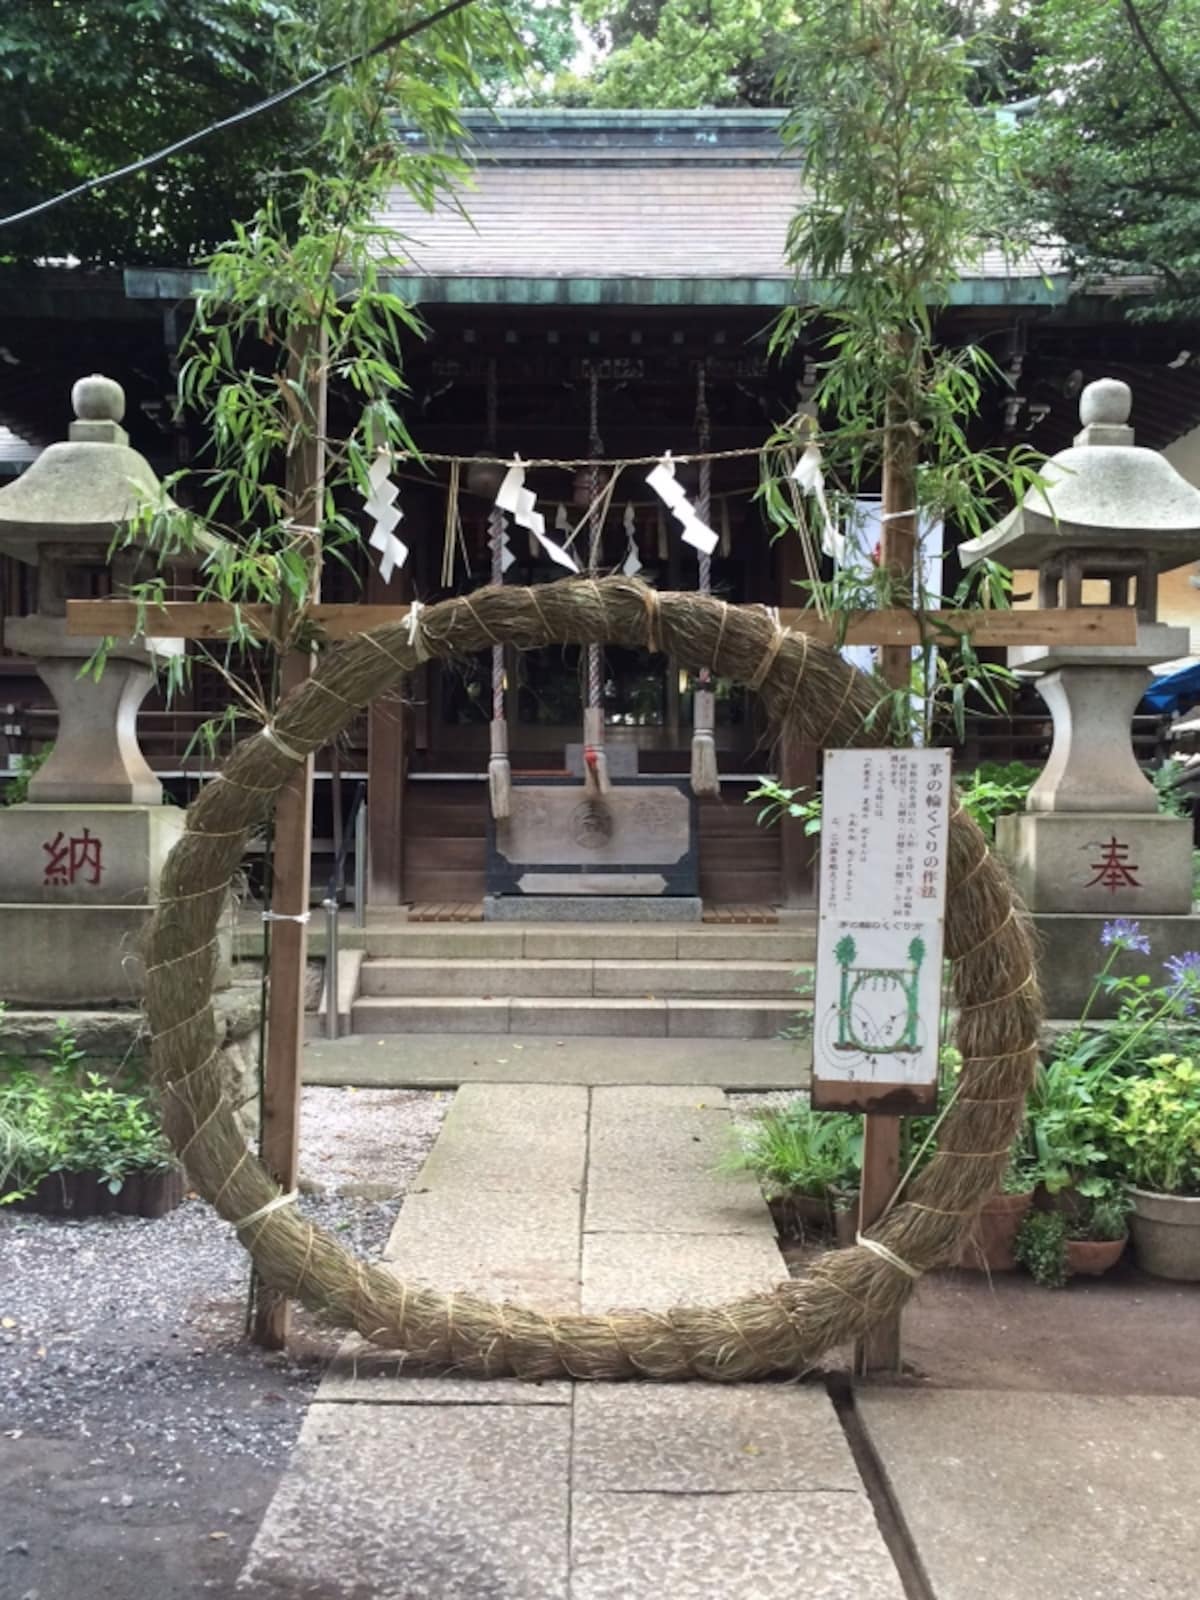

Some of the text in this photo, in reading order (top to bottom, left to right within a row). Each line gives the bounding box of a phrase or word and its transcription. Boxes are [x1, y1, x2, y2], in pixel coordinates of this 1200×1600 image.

[43, 827, 106, 886] 納
[922, 763, 943, 898] 茅の輪くぐりの作法
[1083, 836, 1142, 895] 奉
